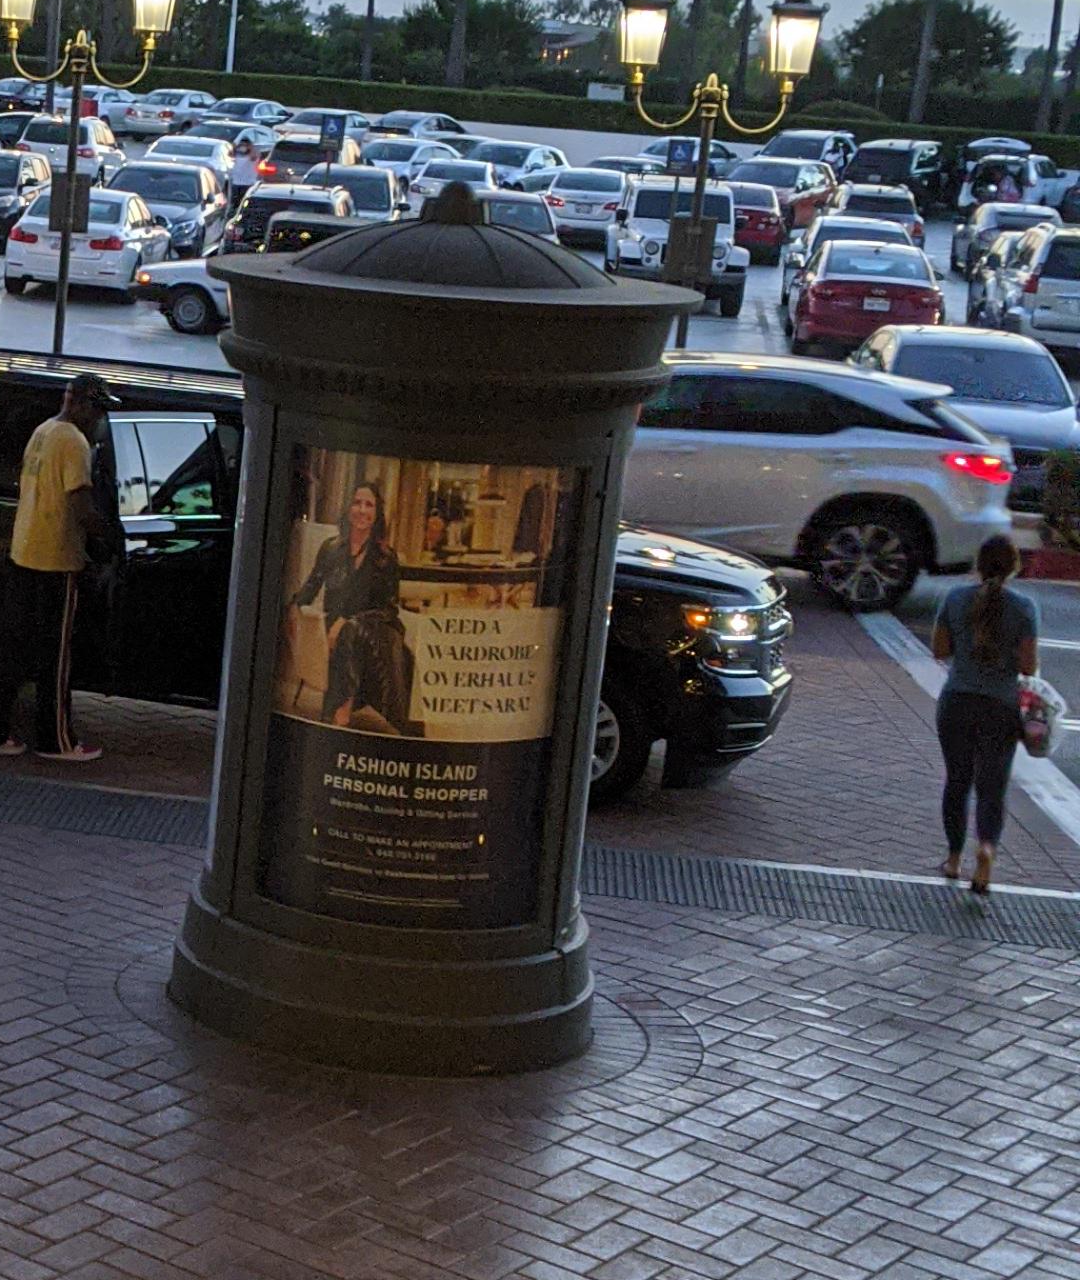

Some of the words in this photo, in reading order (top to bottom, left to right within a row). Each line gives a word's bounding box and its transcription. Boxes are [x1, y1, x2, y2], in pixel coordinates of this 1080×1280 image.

[430, 617, 486, 635] NEED
[489, 619, 502, 635] A
[427, 644, 536, 661] WARDROBE
[423, 670, 536, 688] OVERHAUL?
[422, 696, 480, 714] MEET
[336, 752, 410, 778] FASHION
[415, 762, 479, 782] ISLAND
[323, 773, 409, 799] PERSONAL
[413, 786, 490, 801] SHOPPER
